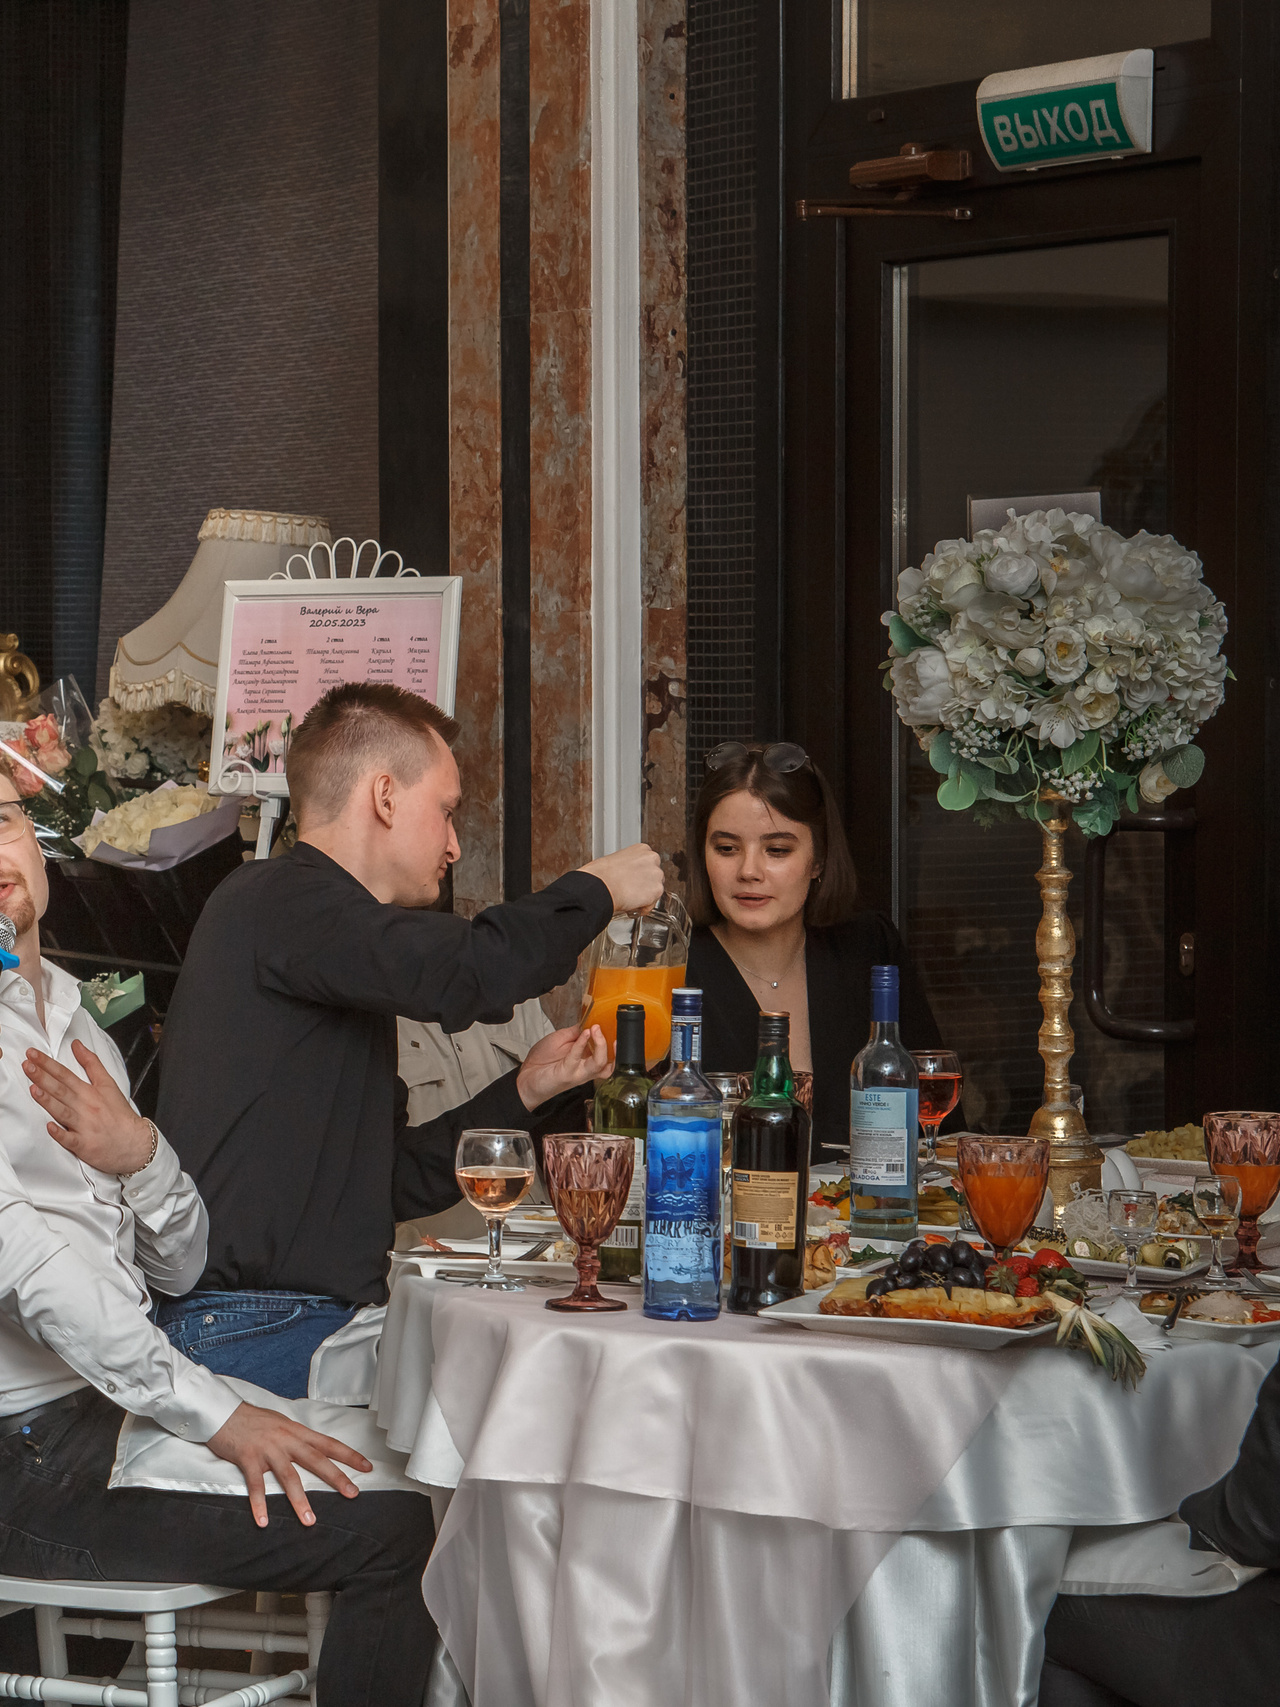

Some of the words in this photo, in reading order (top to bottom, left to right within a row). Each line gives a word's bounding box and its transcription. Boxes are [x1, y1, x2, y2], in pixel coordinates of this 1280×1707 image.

[993, 99, 1121, 152] ВЫХОД
[300, 606, 343, 617] Валерий
[356, 606, 379, 616] Вера
[309, 619, 366, 628] 20.05.2023
[367, 657, 395, 666] Александр
[865, 1093, 881, 1102] ESTE
